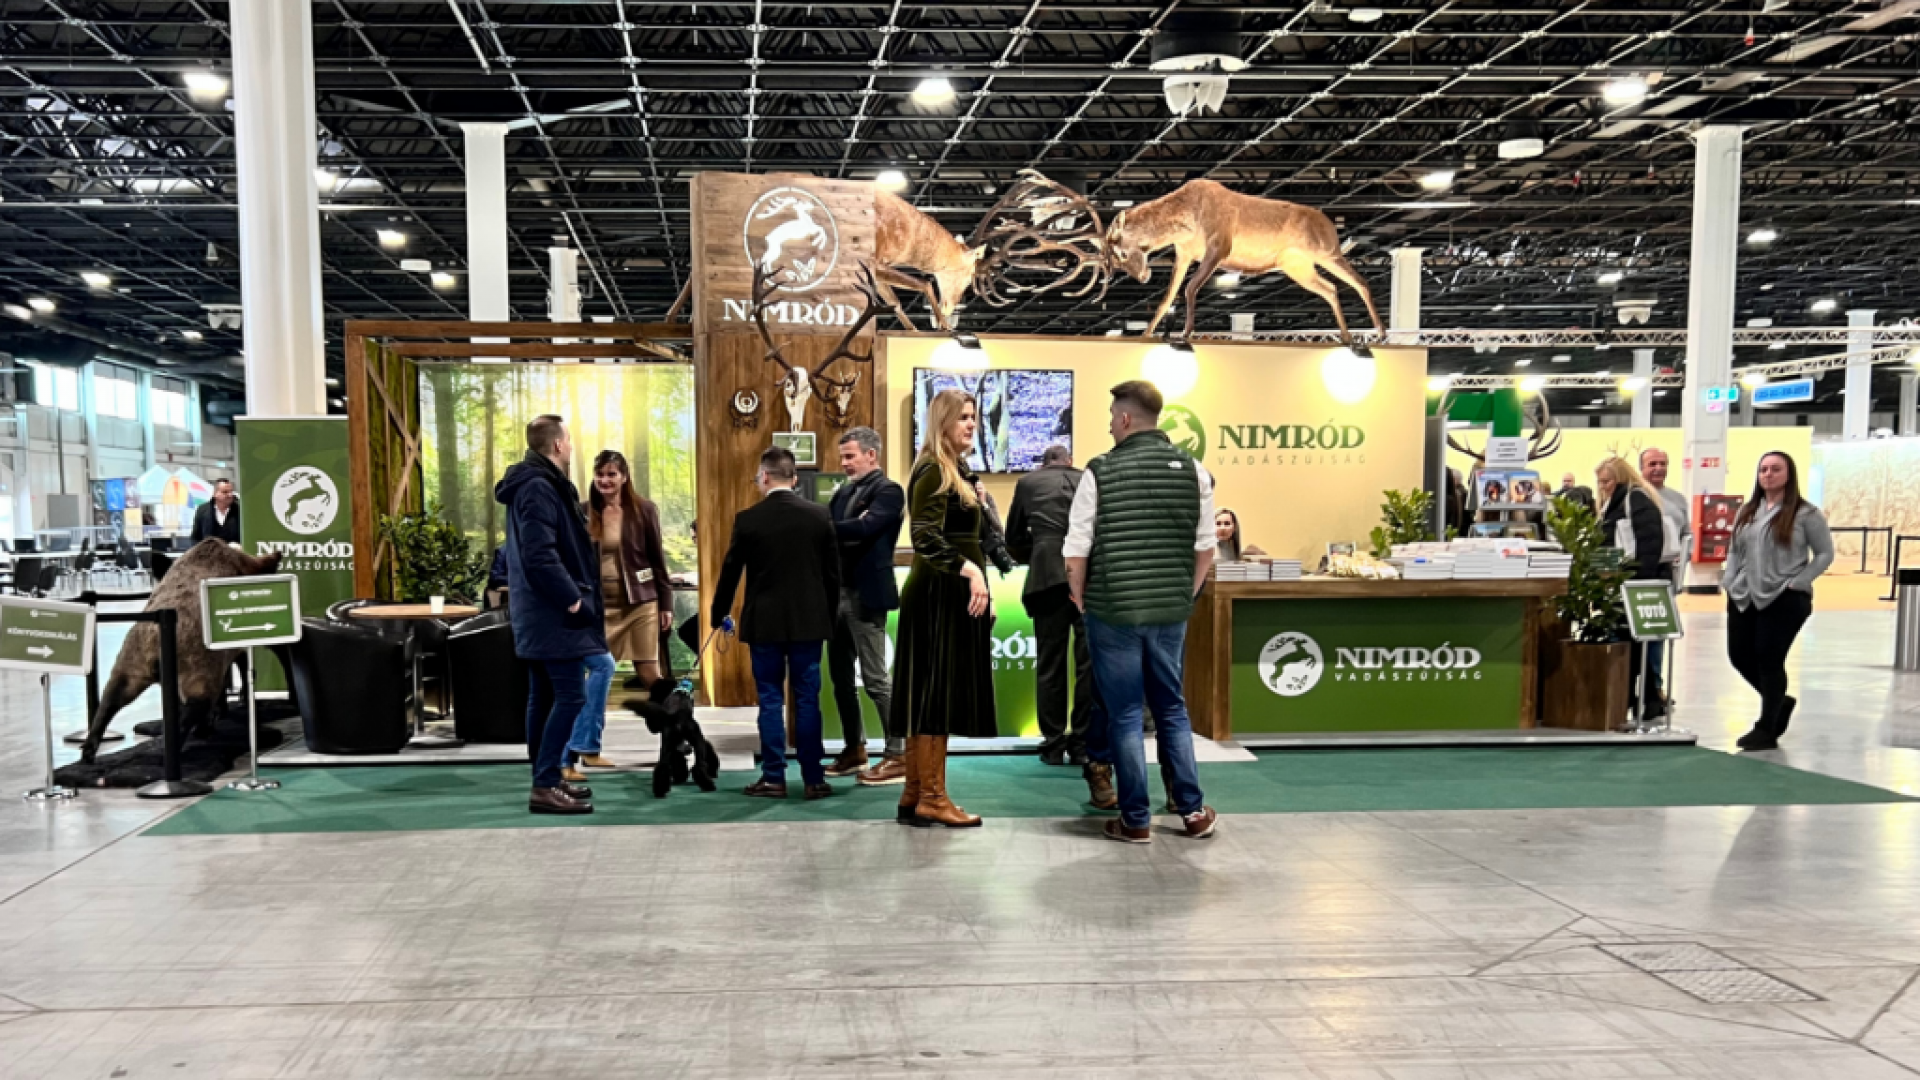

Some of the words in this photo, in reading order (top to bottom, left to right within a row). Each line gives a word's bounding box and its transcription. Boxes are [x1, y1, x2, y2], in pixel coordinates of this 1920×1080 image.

[1218, 418, 1365, 450] NIMRÓD
[1218, 453, 1366, 466] VADÁSZÚJSÁG
[1636, 601, 1668, 619] TOTÓ
[1334, 641, 1482, 670] NIMRÓD
[1334, 669, 1482, 682] VADÁSZÚJSÁG
